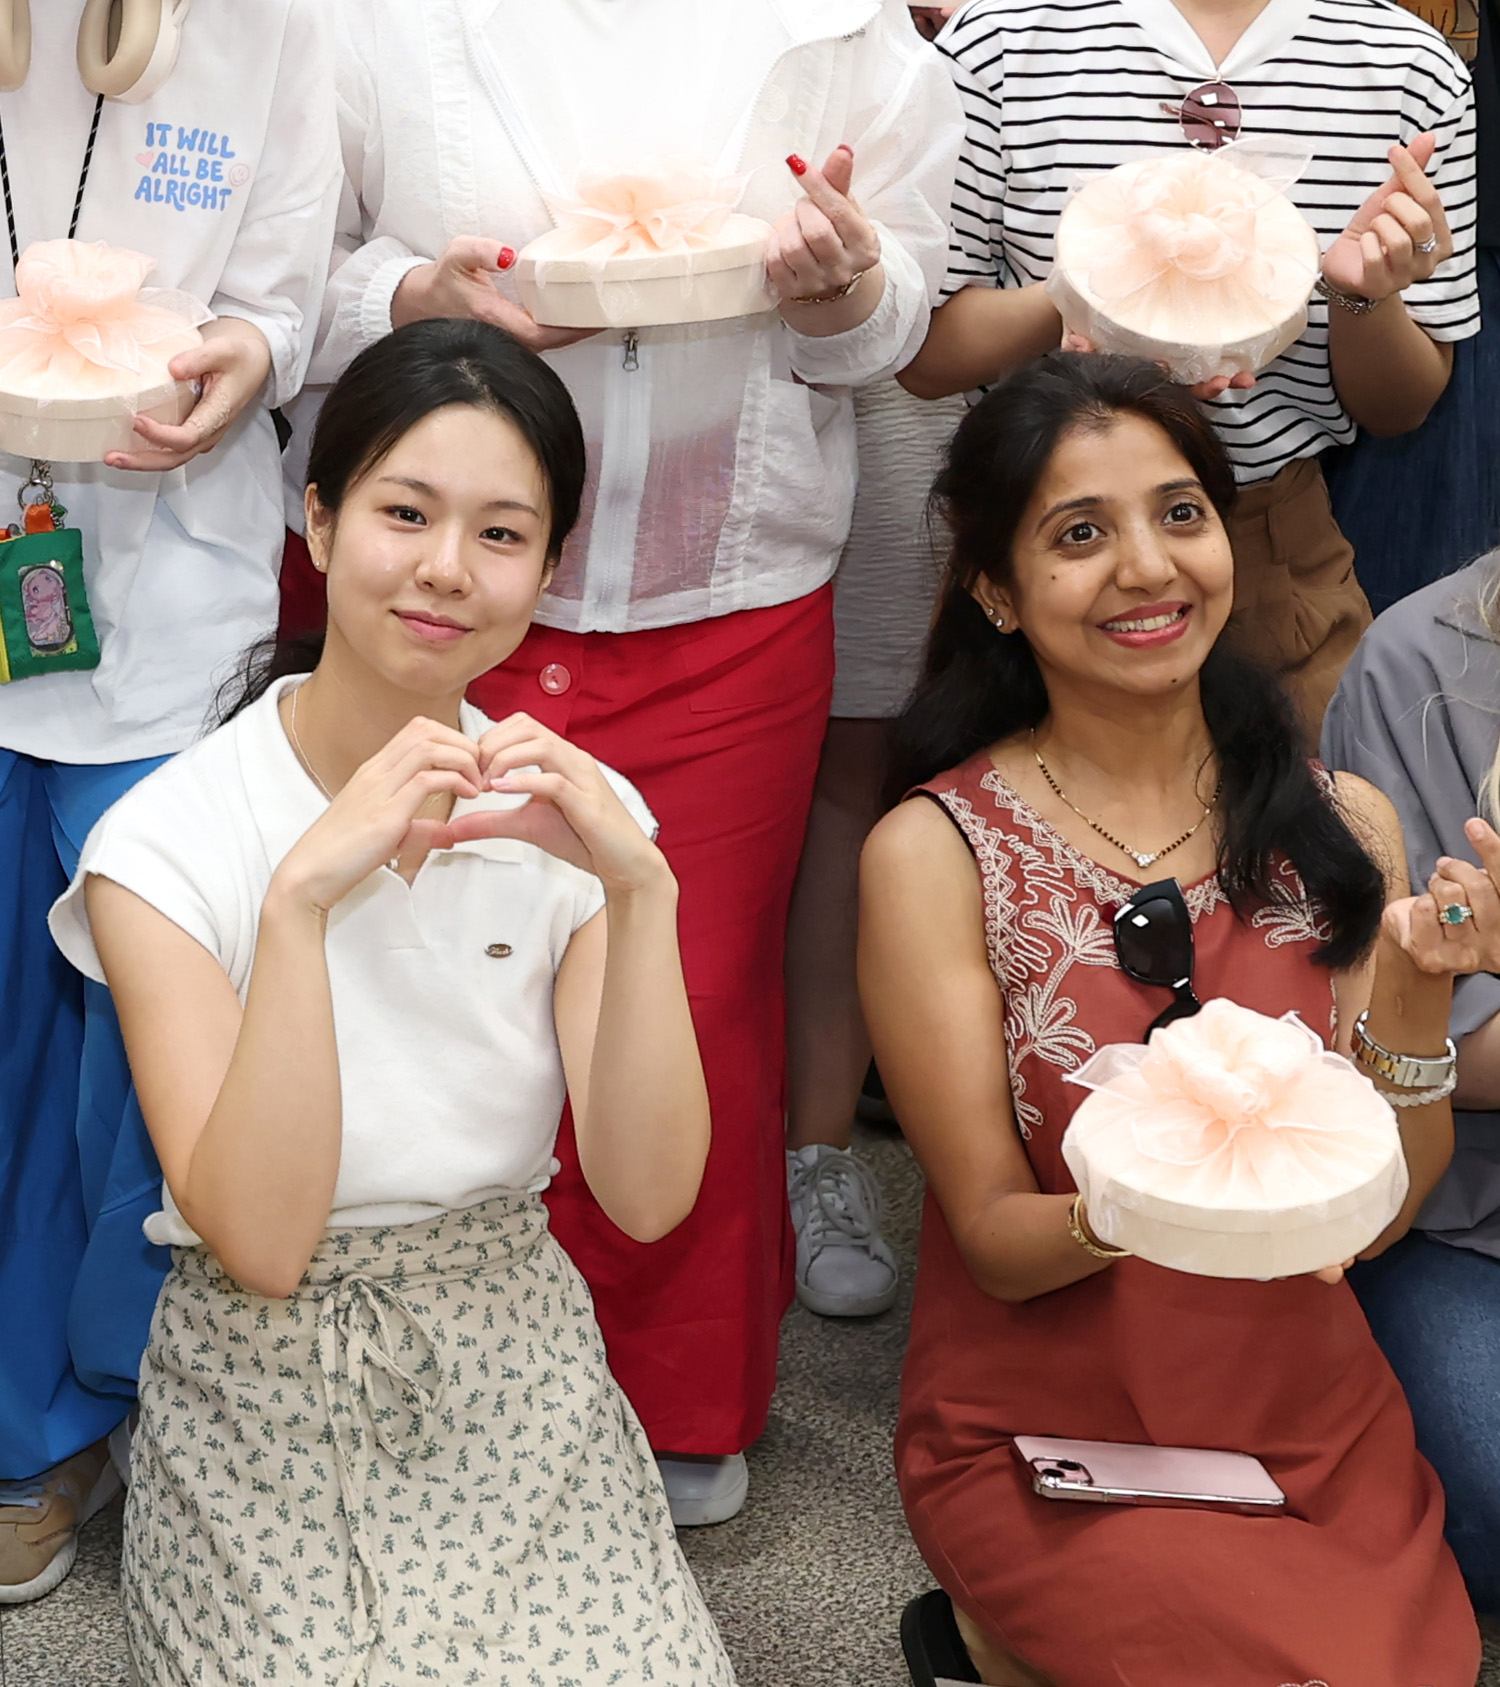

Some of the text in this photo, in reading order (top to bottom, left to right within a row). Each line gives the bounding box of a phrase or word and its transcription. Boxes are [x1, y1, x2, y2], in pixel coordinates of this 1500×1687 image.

[145, 122, 236, 159] IT WILL
[151, 151, 223, 182] ALL BE
[134, 175, 233, 212] ALRIGHT
